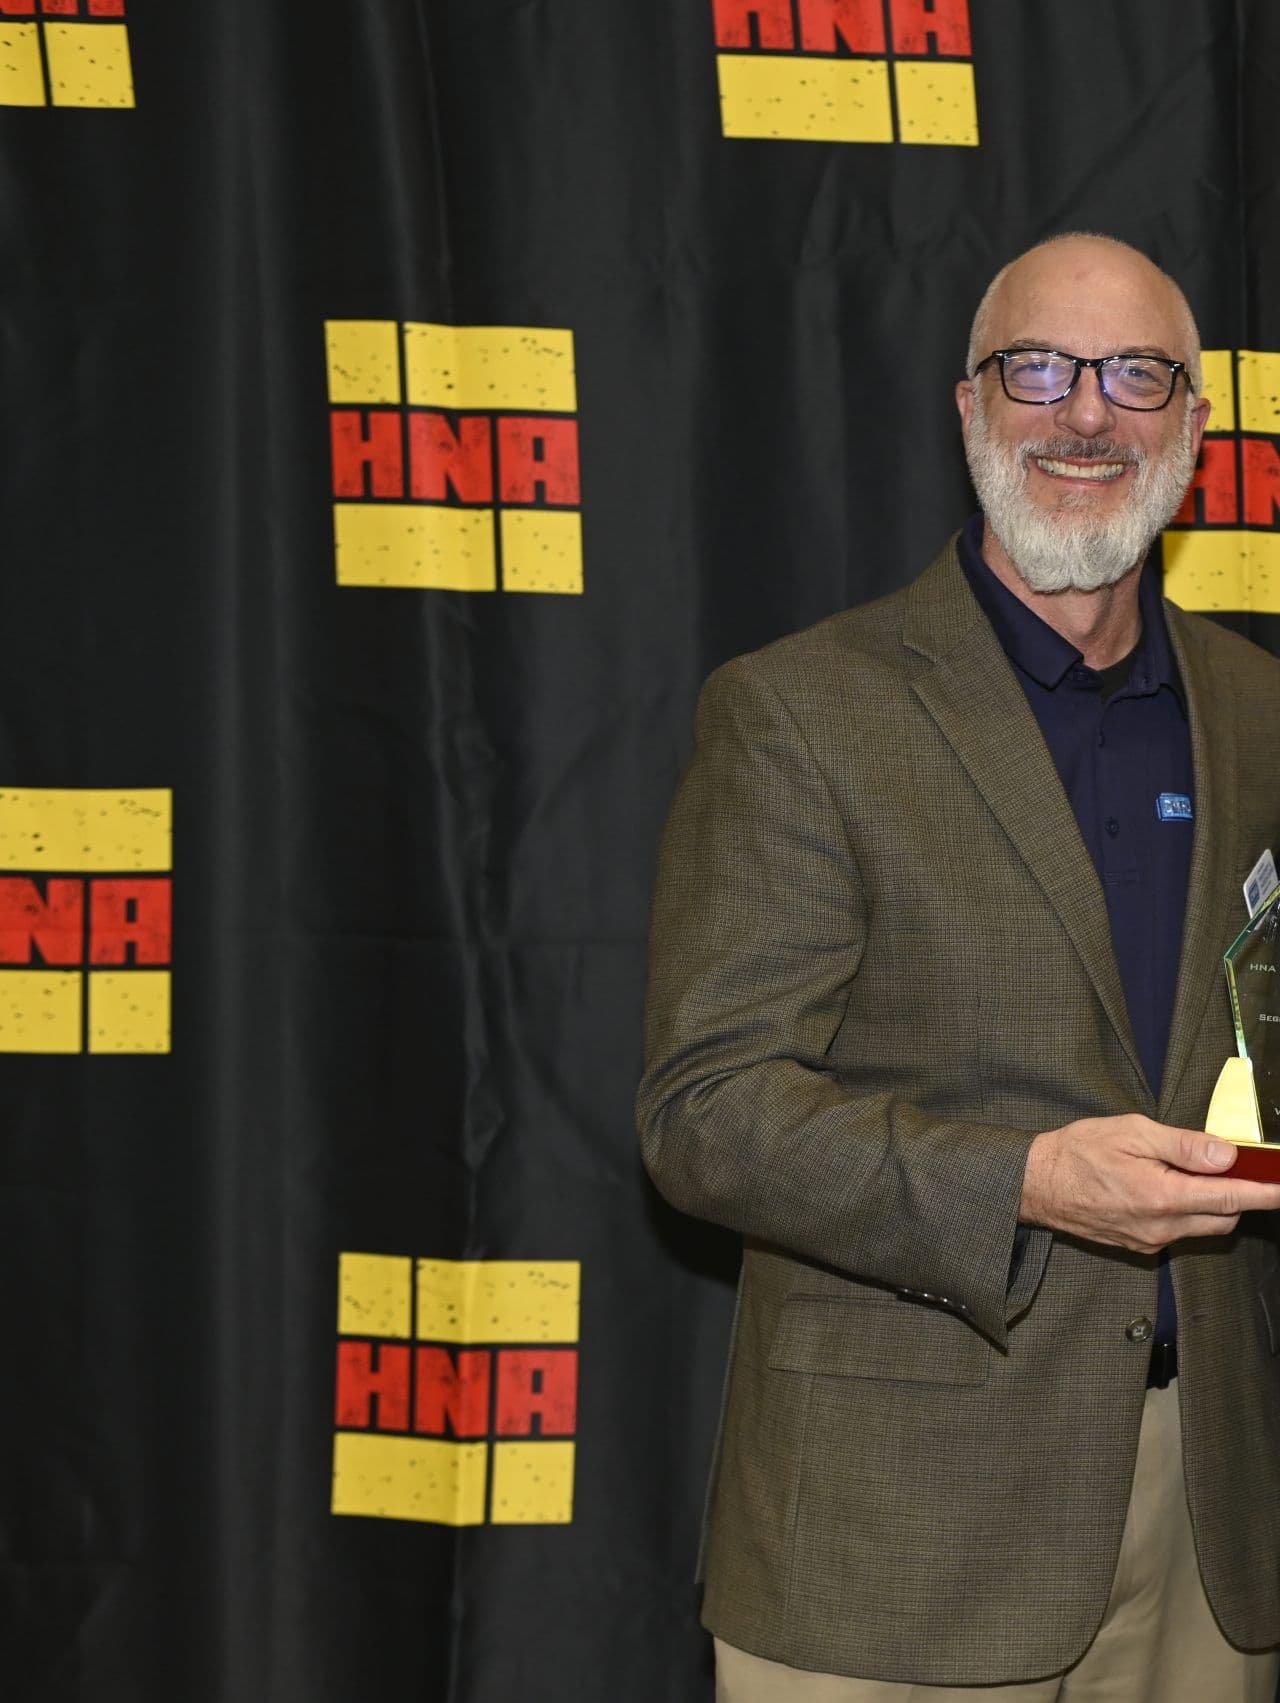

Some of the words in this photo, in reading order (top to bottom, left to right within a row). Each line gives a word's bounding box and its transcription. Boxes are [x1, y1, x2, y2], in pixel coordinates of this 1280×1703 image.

[330, 411, 580, 505] HNA
[1250, 963, 1276, 972] HNA
[335, 1341, 579, 1438] HNA
